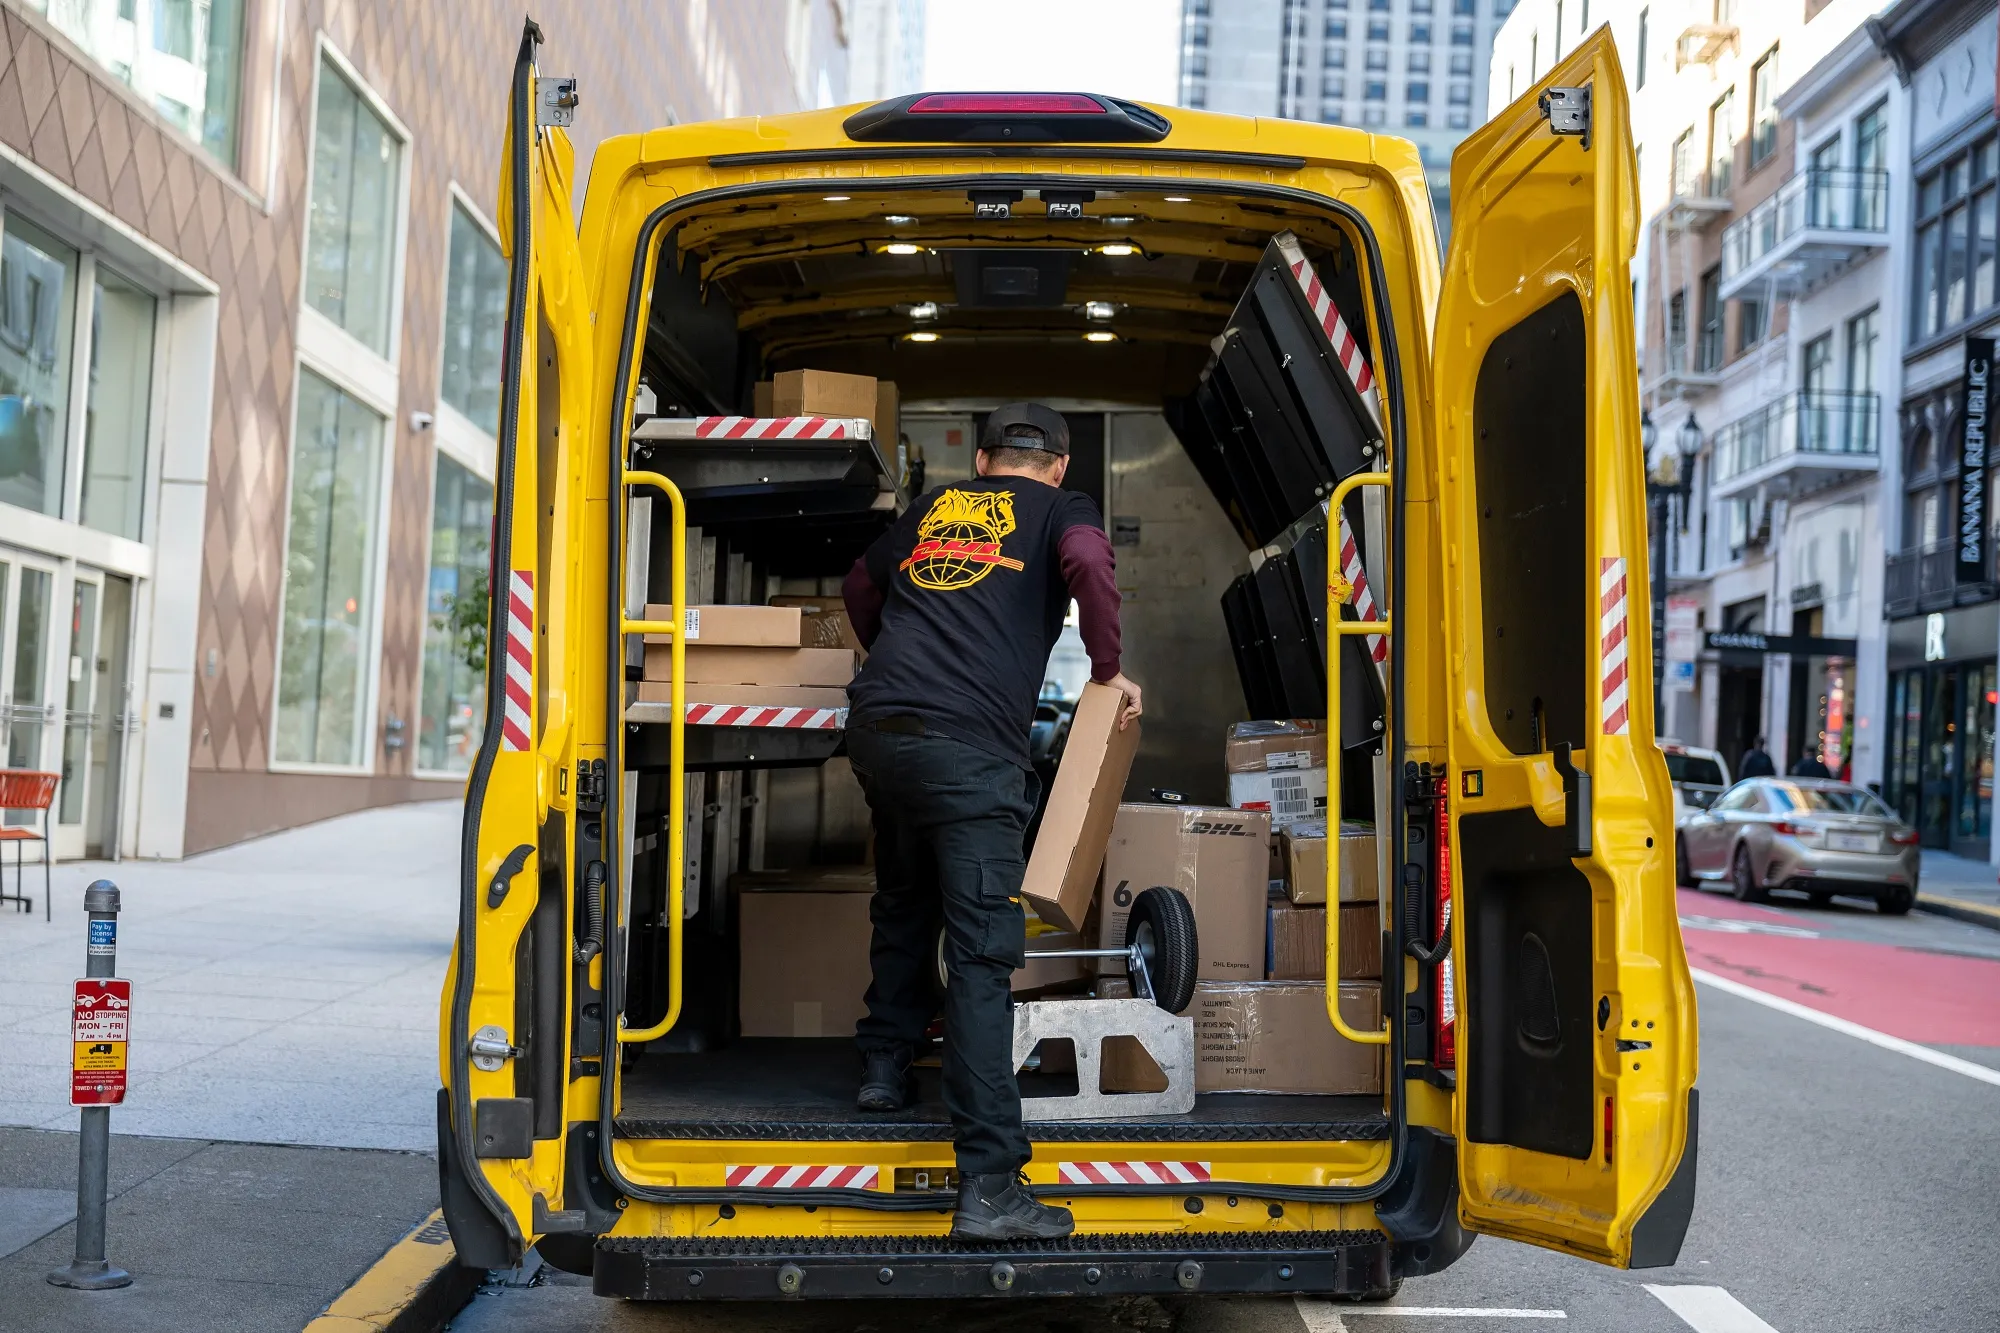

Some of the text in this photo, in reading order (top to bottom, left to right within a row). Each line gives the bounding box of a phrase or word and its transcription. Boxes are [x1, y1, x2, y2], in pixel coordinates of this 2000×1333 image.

[1960, 358, 1989, 563] BANANA REPUBLIC
[906, 540, 1006, 565] DHL
[1709, 632, 1768, 649] CHANEL
[1188, 821, 1248, 837] DHL
[1113, 880, 1132, 907] 6
[78, 1011, 93, 1020] NO
